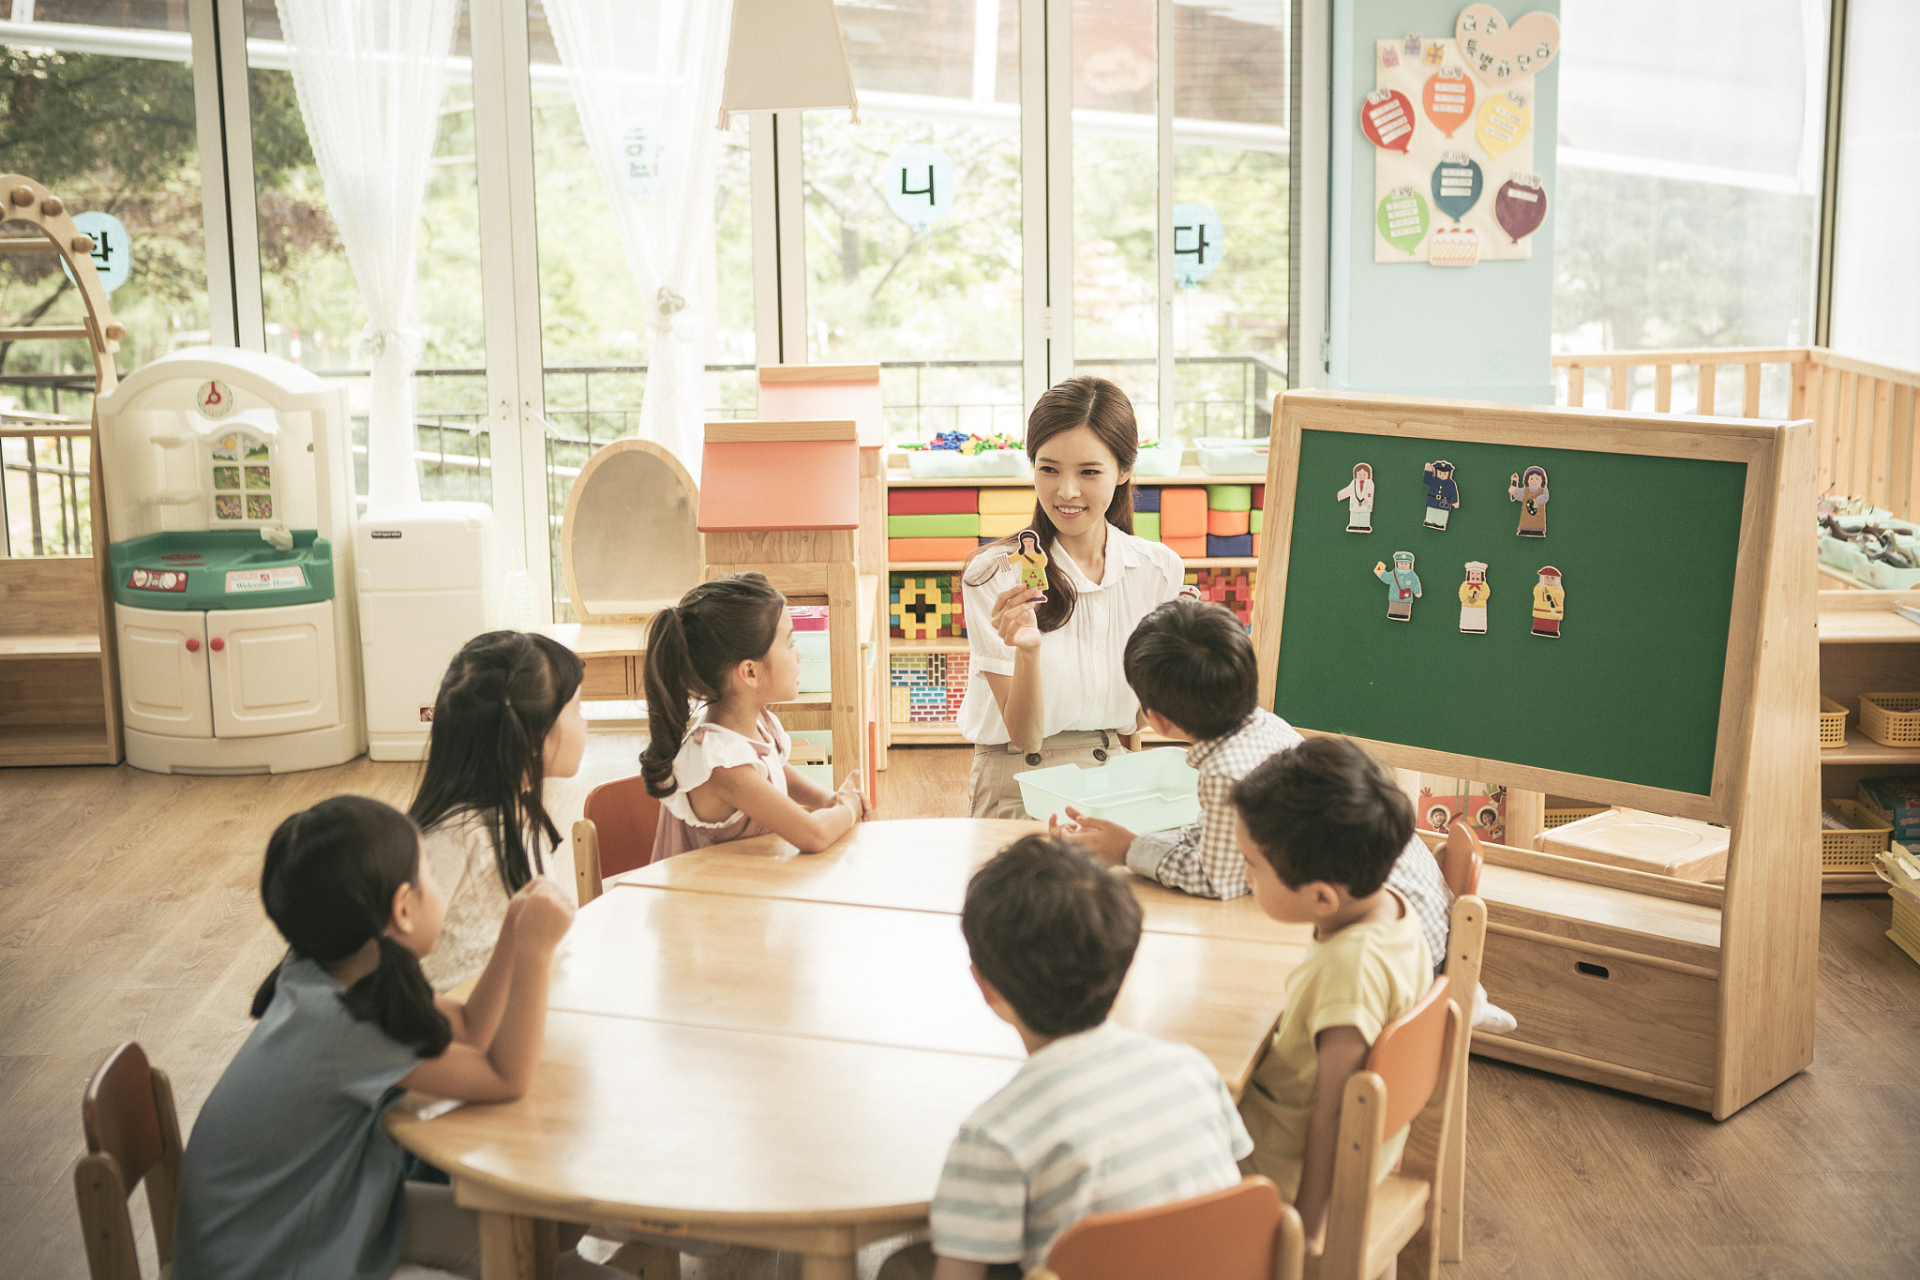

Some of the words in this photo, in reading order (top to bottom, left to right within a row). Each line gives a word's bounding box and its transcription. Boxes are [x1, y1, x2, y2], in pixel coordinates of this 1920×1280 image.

[1463, 14, 1498, 35] 너는
[1173, 224, 1210, 264] 다
[235, 581, 271, 590] Welcome
[272, 579, 295, 587] Home
